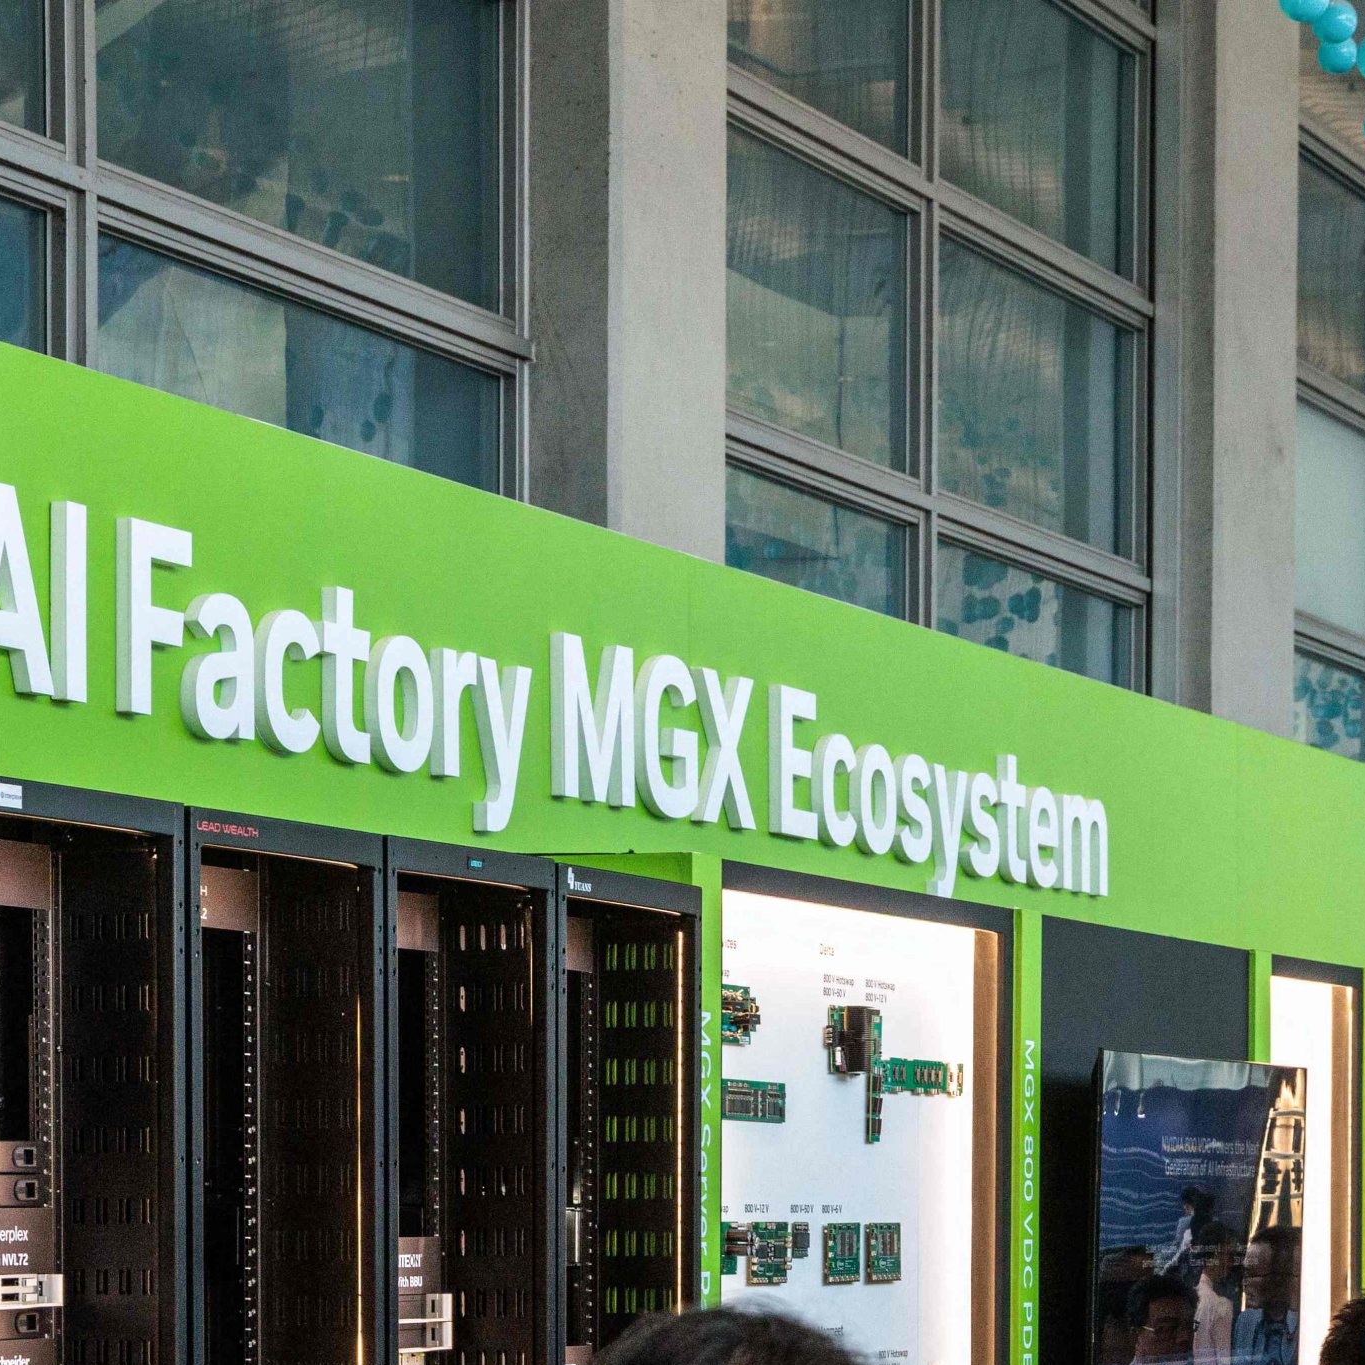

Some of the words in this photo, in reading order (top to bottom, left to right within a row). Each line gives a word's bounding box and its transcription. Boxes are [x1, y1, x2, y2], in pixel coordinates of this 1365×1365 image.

[116, 516, 531, 833] Factory
[549, 632, 756, 831] MGX
[768, 683, 1109, 897] Ecosystem
[196, 820, 221, 833] LEAD
[222, 824, 259, 838] WEALTH
[1022, 1039, 1035, 1126] MGX
[1022, 1139, 1034, 1202] 800
[2, 1253, 29, 1266] NVL72
[1022, 1218, 1034, 1287] VDC
